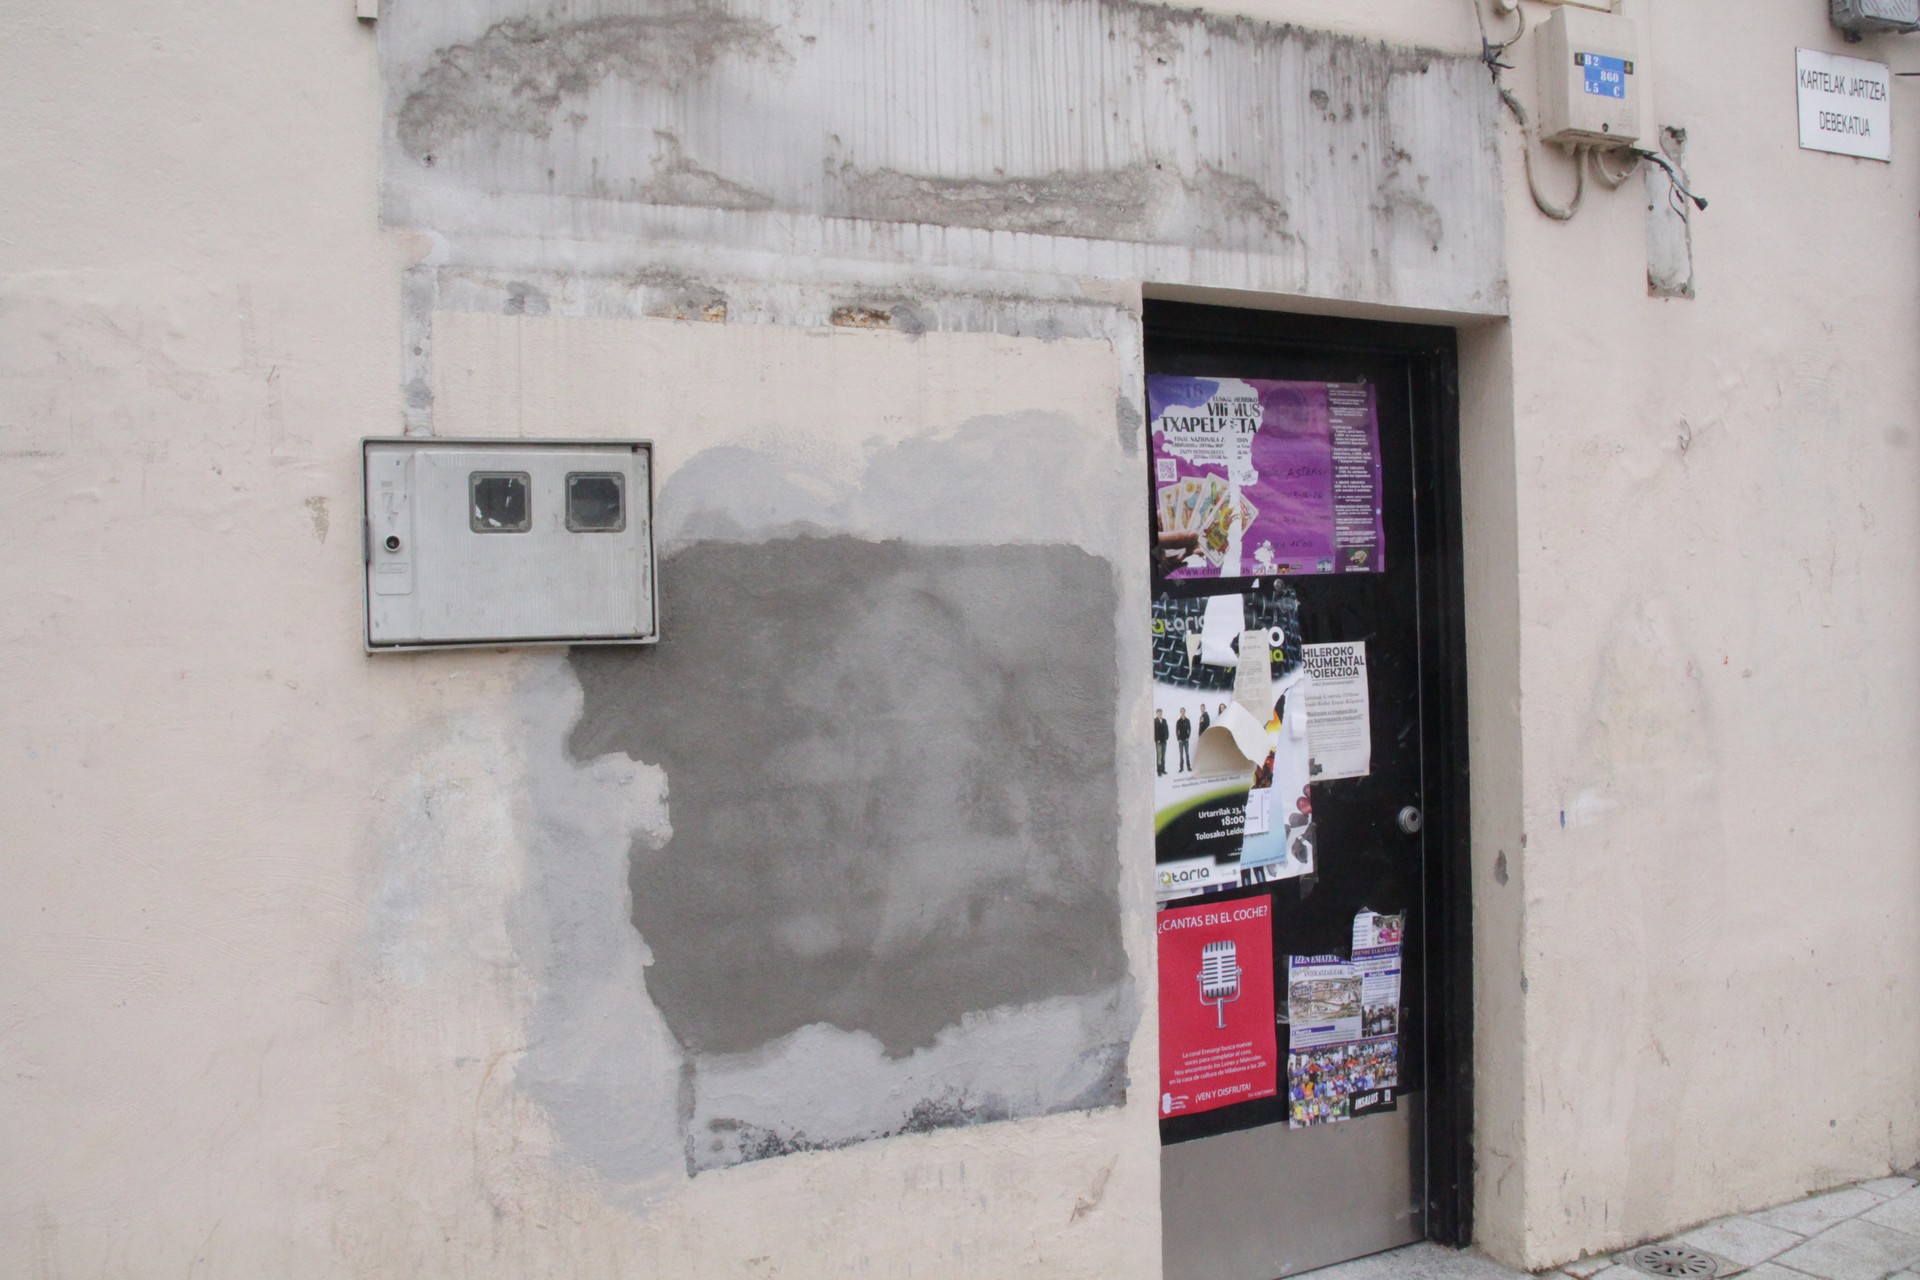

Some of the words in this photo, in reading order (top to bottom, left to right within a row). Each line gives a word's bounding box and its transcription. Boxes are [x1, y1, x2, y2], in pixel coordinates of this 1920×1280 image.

[1593, 56, 1599, 67] 2
[1600, 70, 1619, 83] 860
[1593, 82, 1599, 94] 5
[1800, 69, 1846, 95] KARTELAK
[1849, 77, 1887, 102] JARTZEA
[1819, 110, 1871, 137] DEBEKATUA
[1302, 646, 1354, 659] HILEROKO
[1198, 807, 1231, 819] Urtarrilak
[1195, 830, 1226, 841] Tolosako
[1158, 915, 1203, 934] ¿CANTAS
[1205, 913, 1218, 926] EN
[1220, 911, 1232, 924] EL
[1233, 905, 1268, 922] COCHE?
[1195, 1092, 1211, 1103] ¡VEN
[1217, 1083, 1252, 1097] DISFRUTA!
